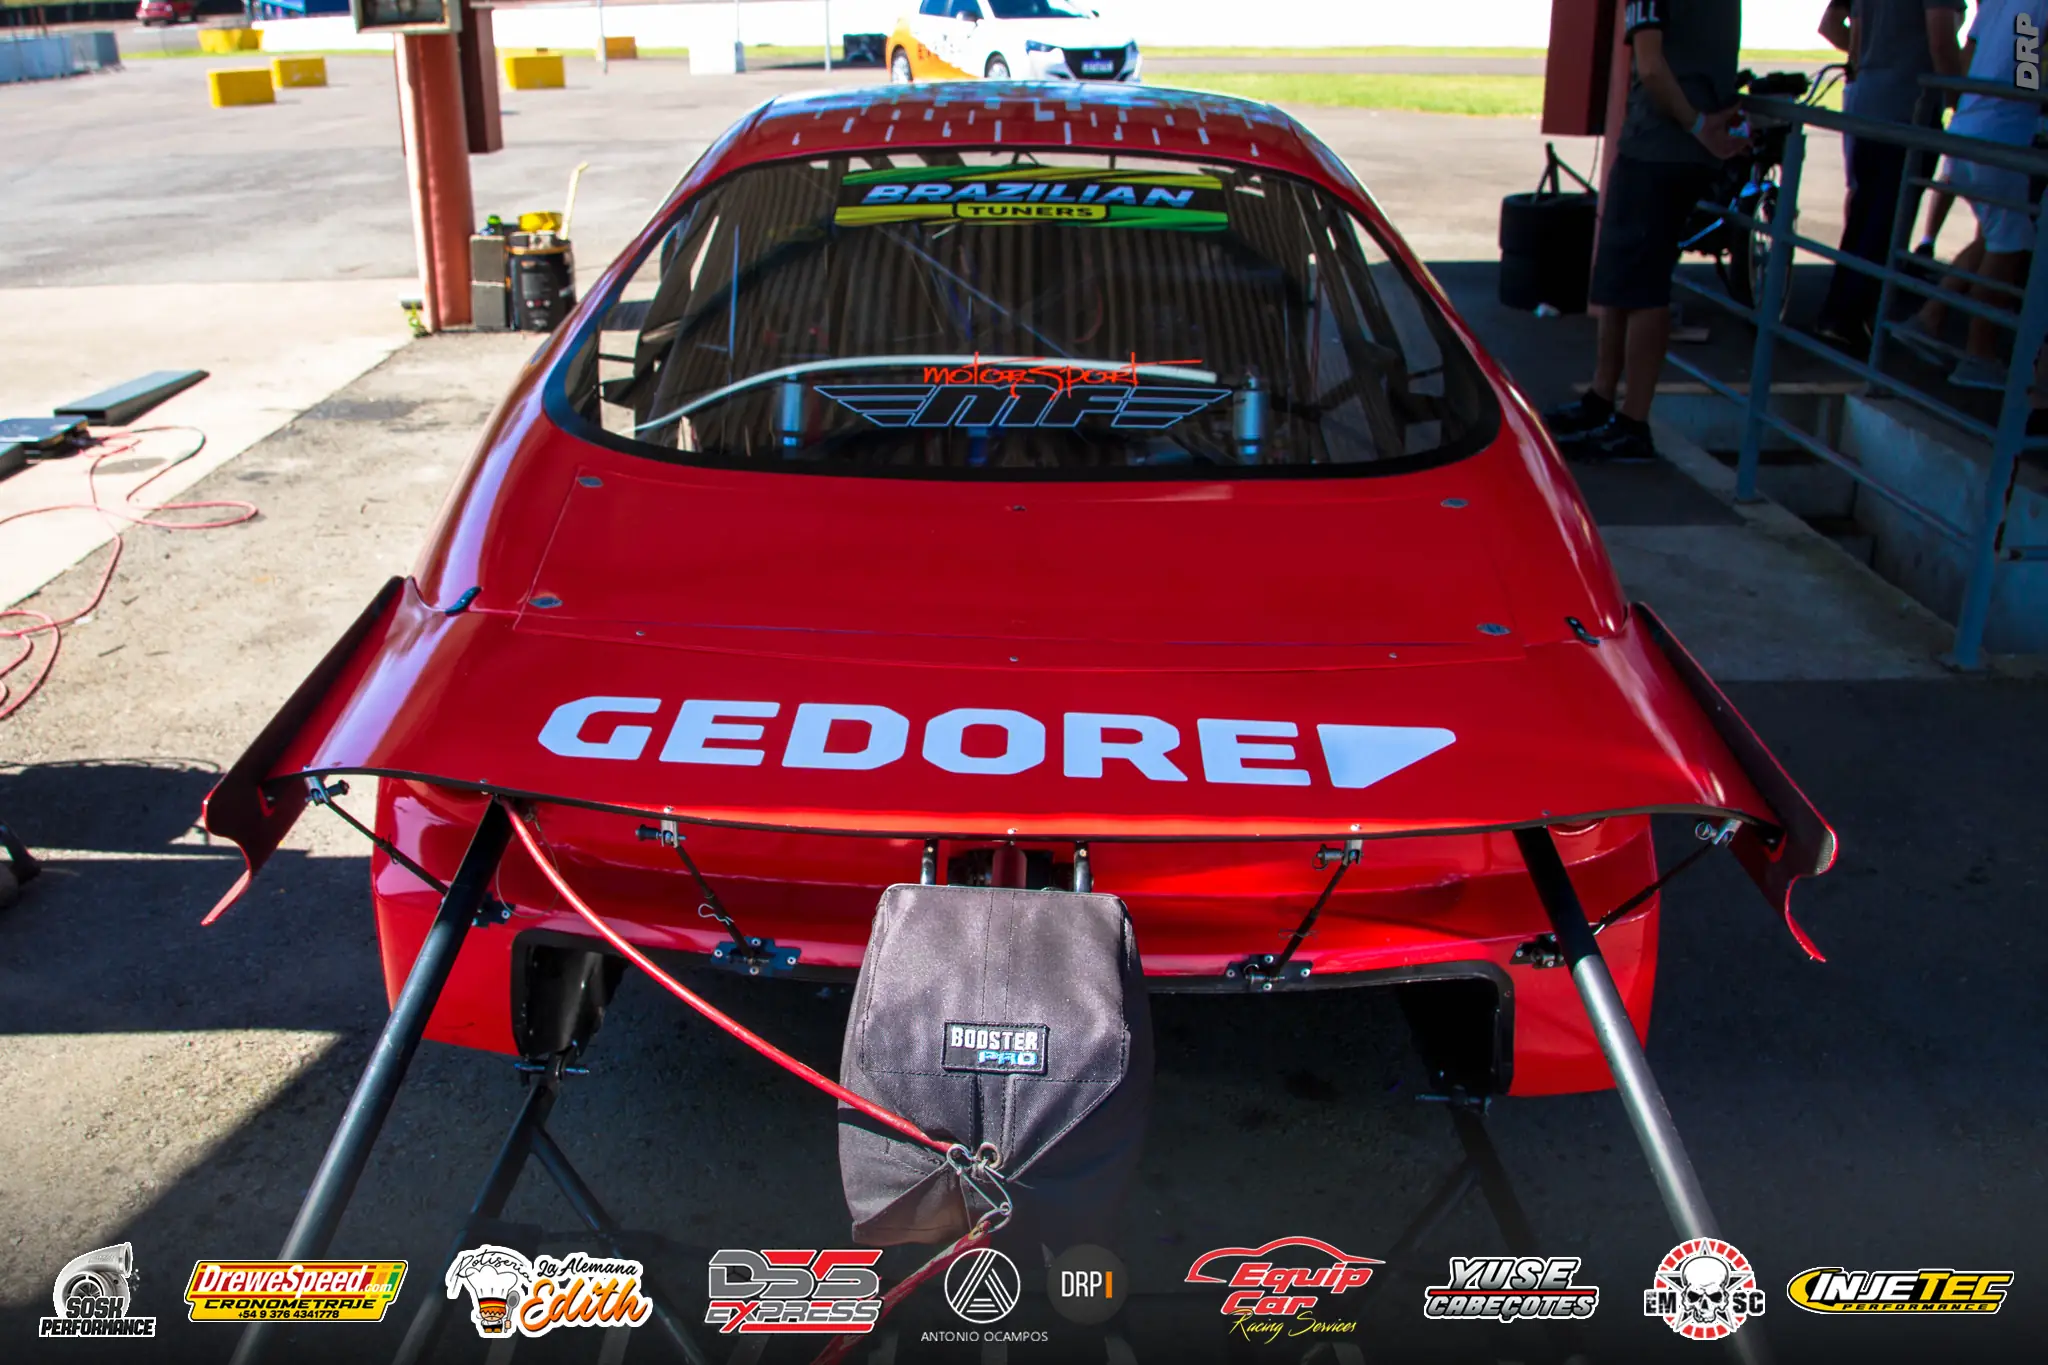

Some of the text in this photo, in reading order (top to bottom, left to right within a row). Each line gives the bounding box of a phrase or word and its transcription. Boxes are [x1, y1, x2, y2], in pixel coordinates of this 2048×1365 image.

[861, 182, 1195, 208] BRAZILIAN
[967, 205, 1094, 218] TUNERS
[537, 696, 1312, 787] GEDORE
[951, 1026, 1039, 1051] BOOSTER
[978, 1050, 1038, 1066] PRO
